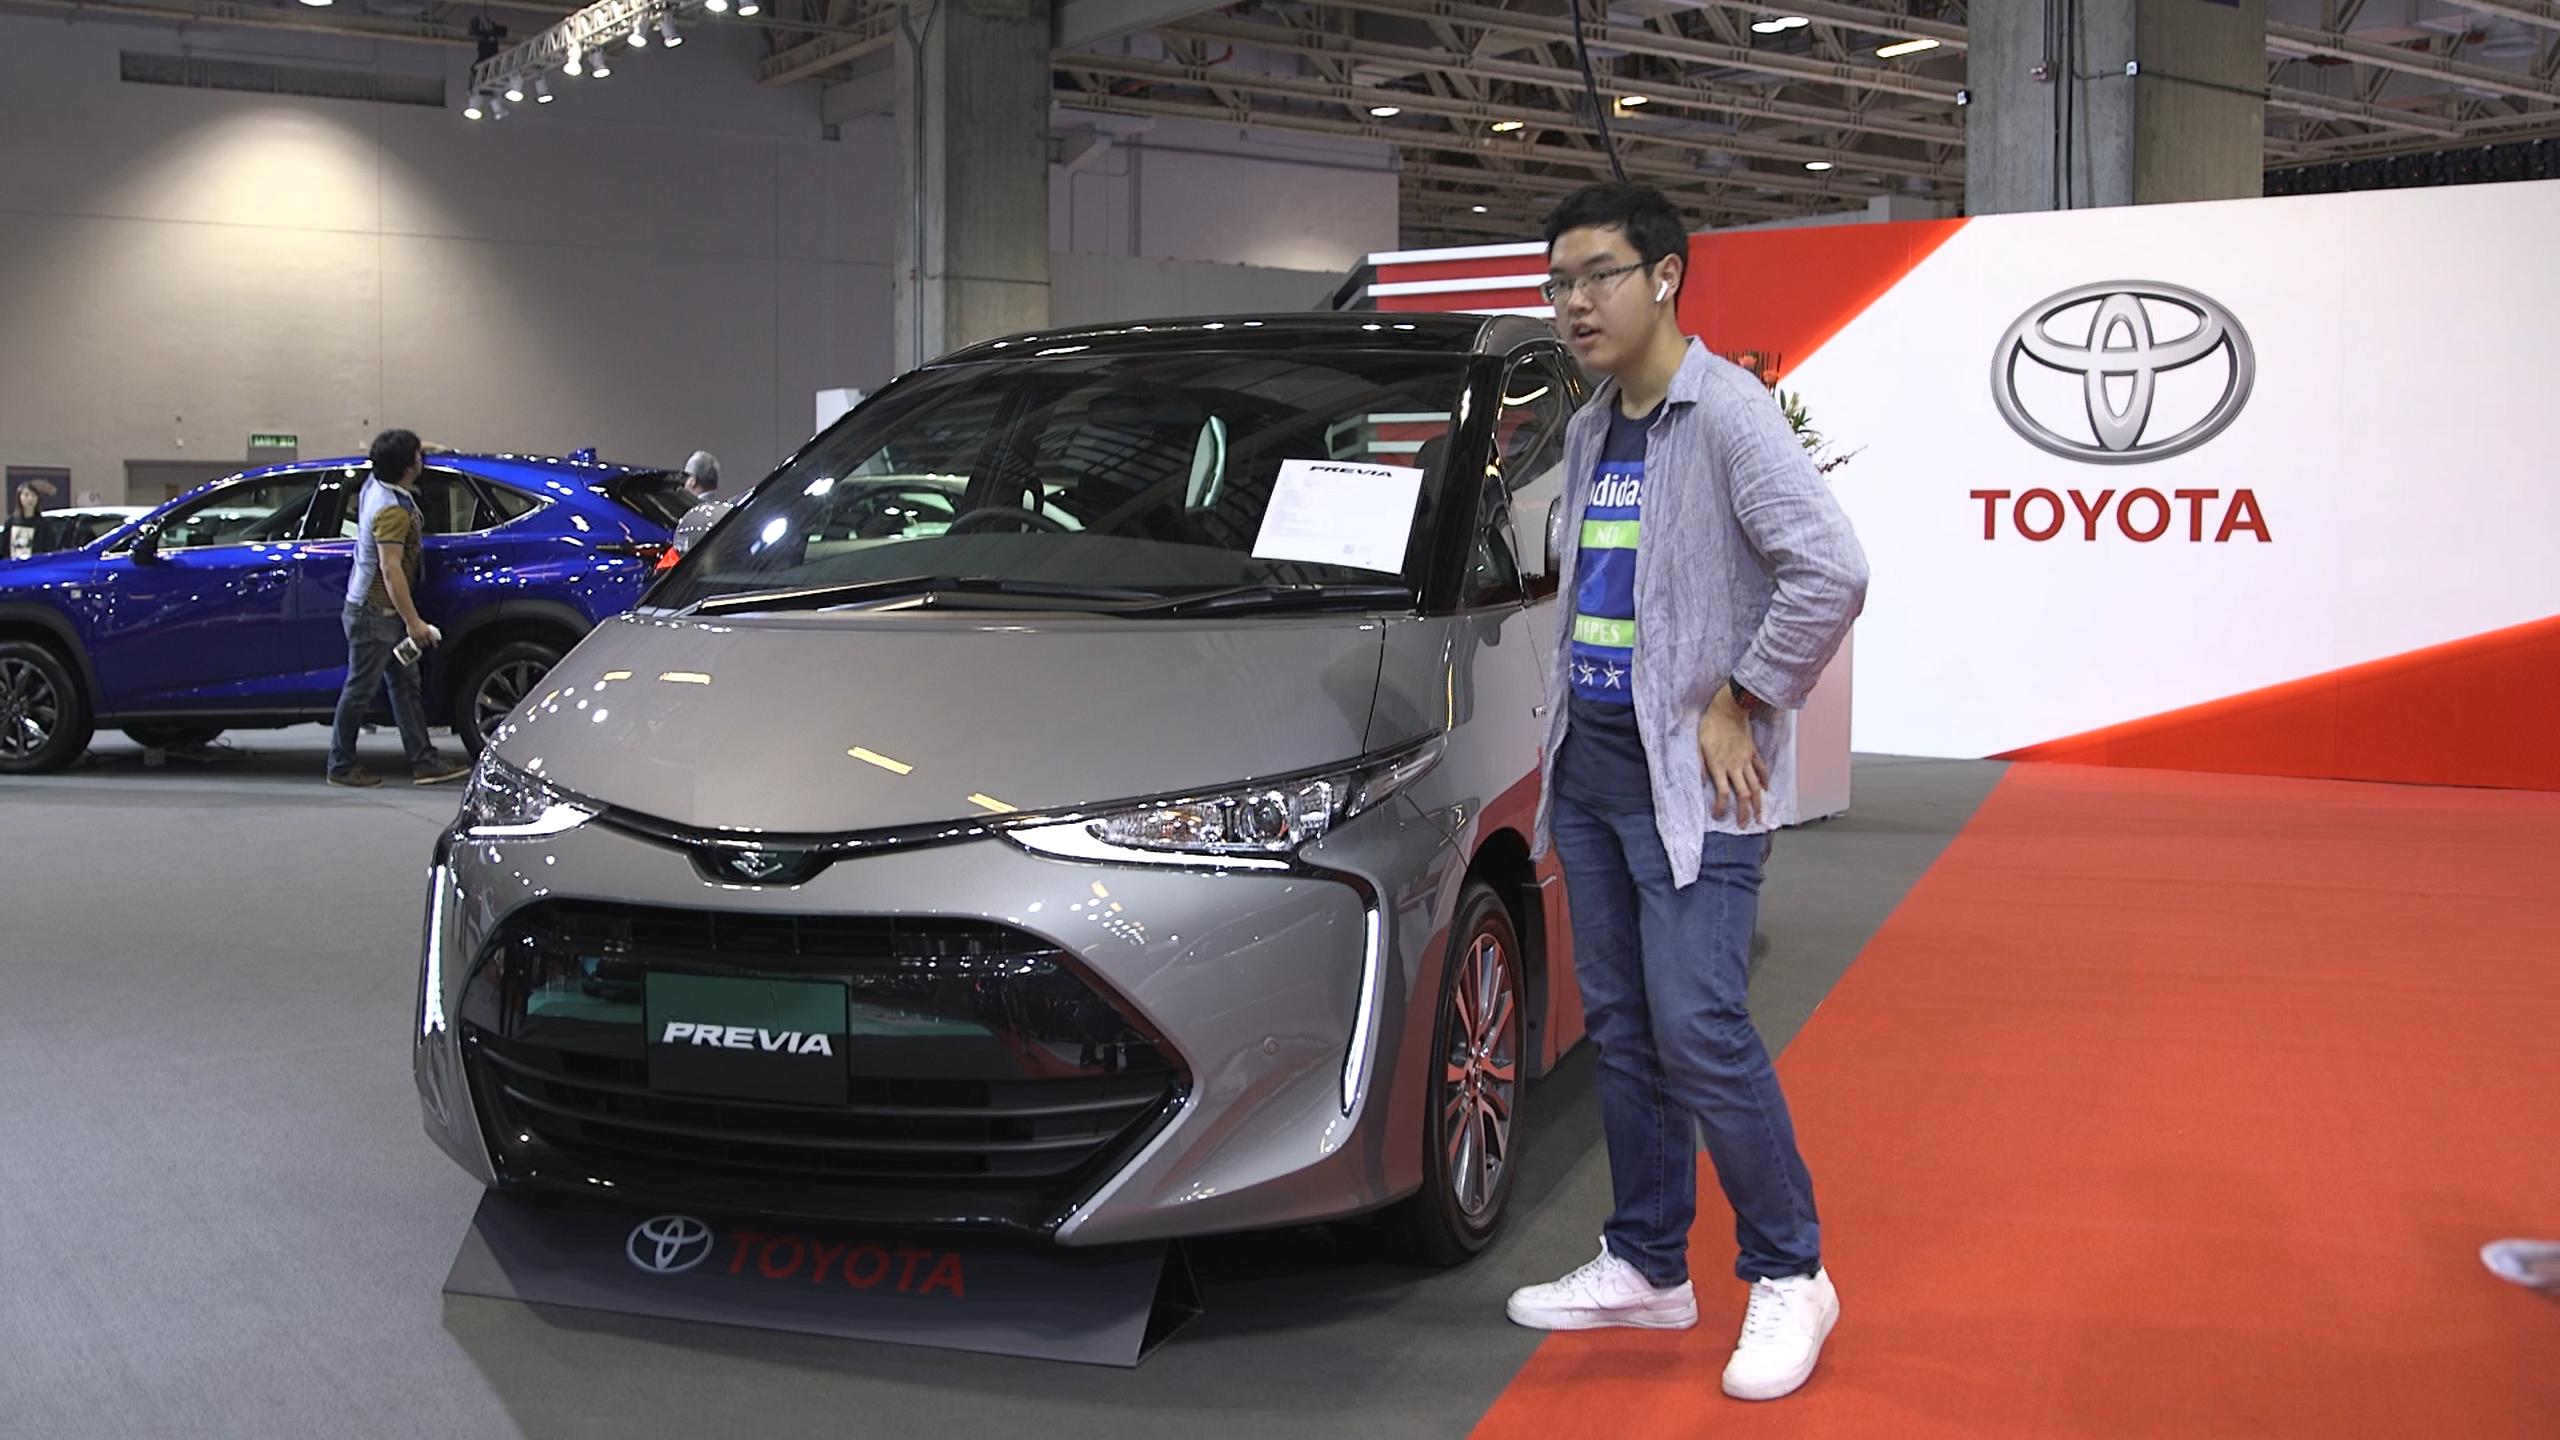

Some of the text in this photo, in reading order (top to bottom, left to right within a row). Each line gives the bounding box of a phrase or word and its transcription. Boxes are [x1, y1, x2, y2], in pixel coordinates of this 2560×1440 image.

[1309, 465, 1393, 478] PREVIA
[1970, 487, 2273, 543] TOYOTA
[662, 1021, 834, 1057] PREVIA
[727, 1231, 967, 1297] TOYOTA
